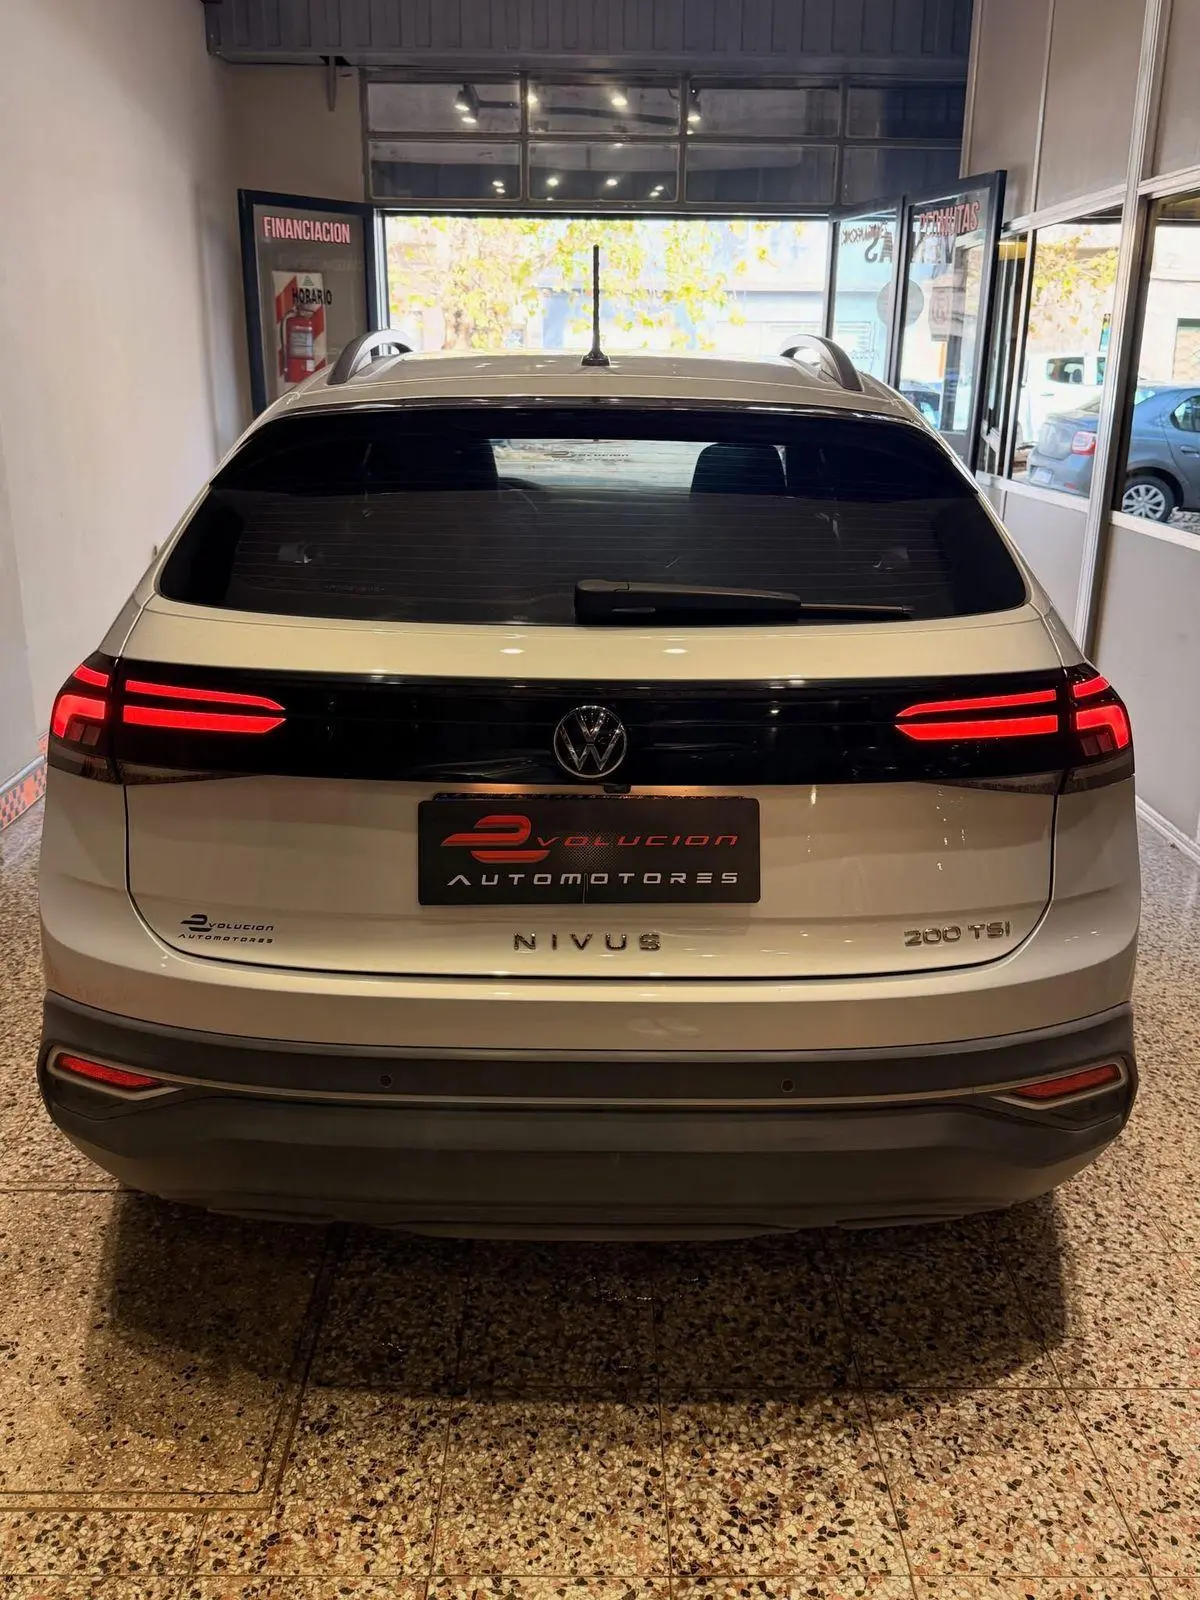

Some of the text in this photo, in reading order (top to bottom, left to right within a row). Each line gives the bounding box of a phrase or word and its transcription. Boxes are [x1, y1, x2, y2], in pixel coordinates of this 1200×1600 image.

[262, 215, 351, 245] FINANCIACION
[291, 287, 333, 305] HORARIO
[447, 872, 738, 886] AUTOMOTORES
[178, 933, 274, 944] AUTOMOTORES
[513, 933, 661, 950] NIVUS
[904, 921, 1010, 947] 200 TSI
